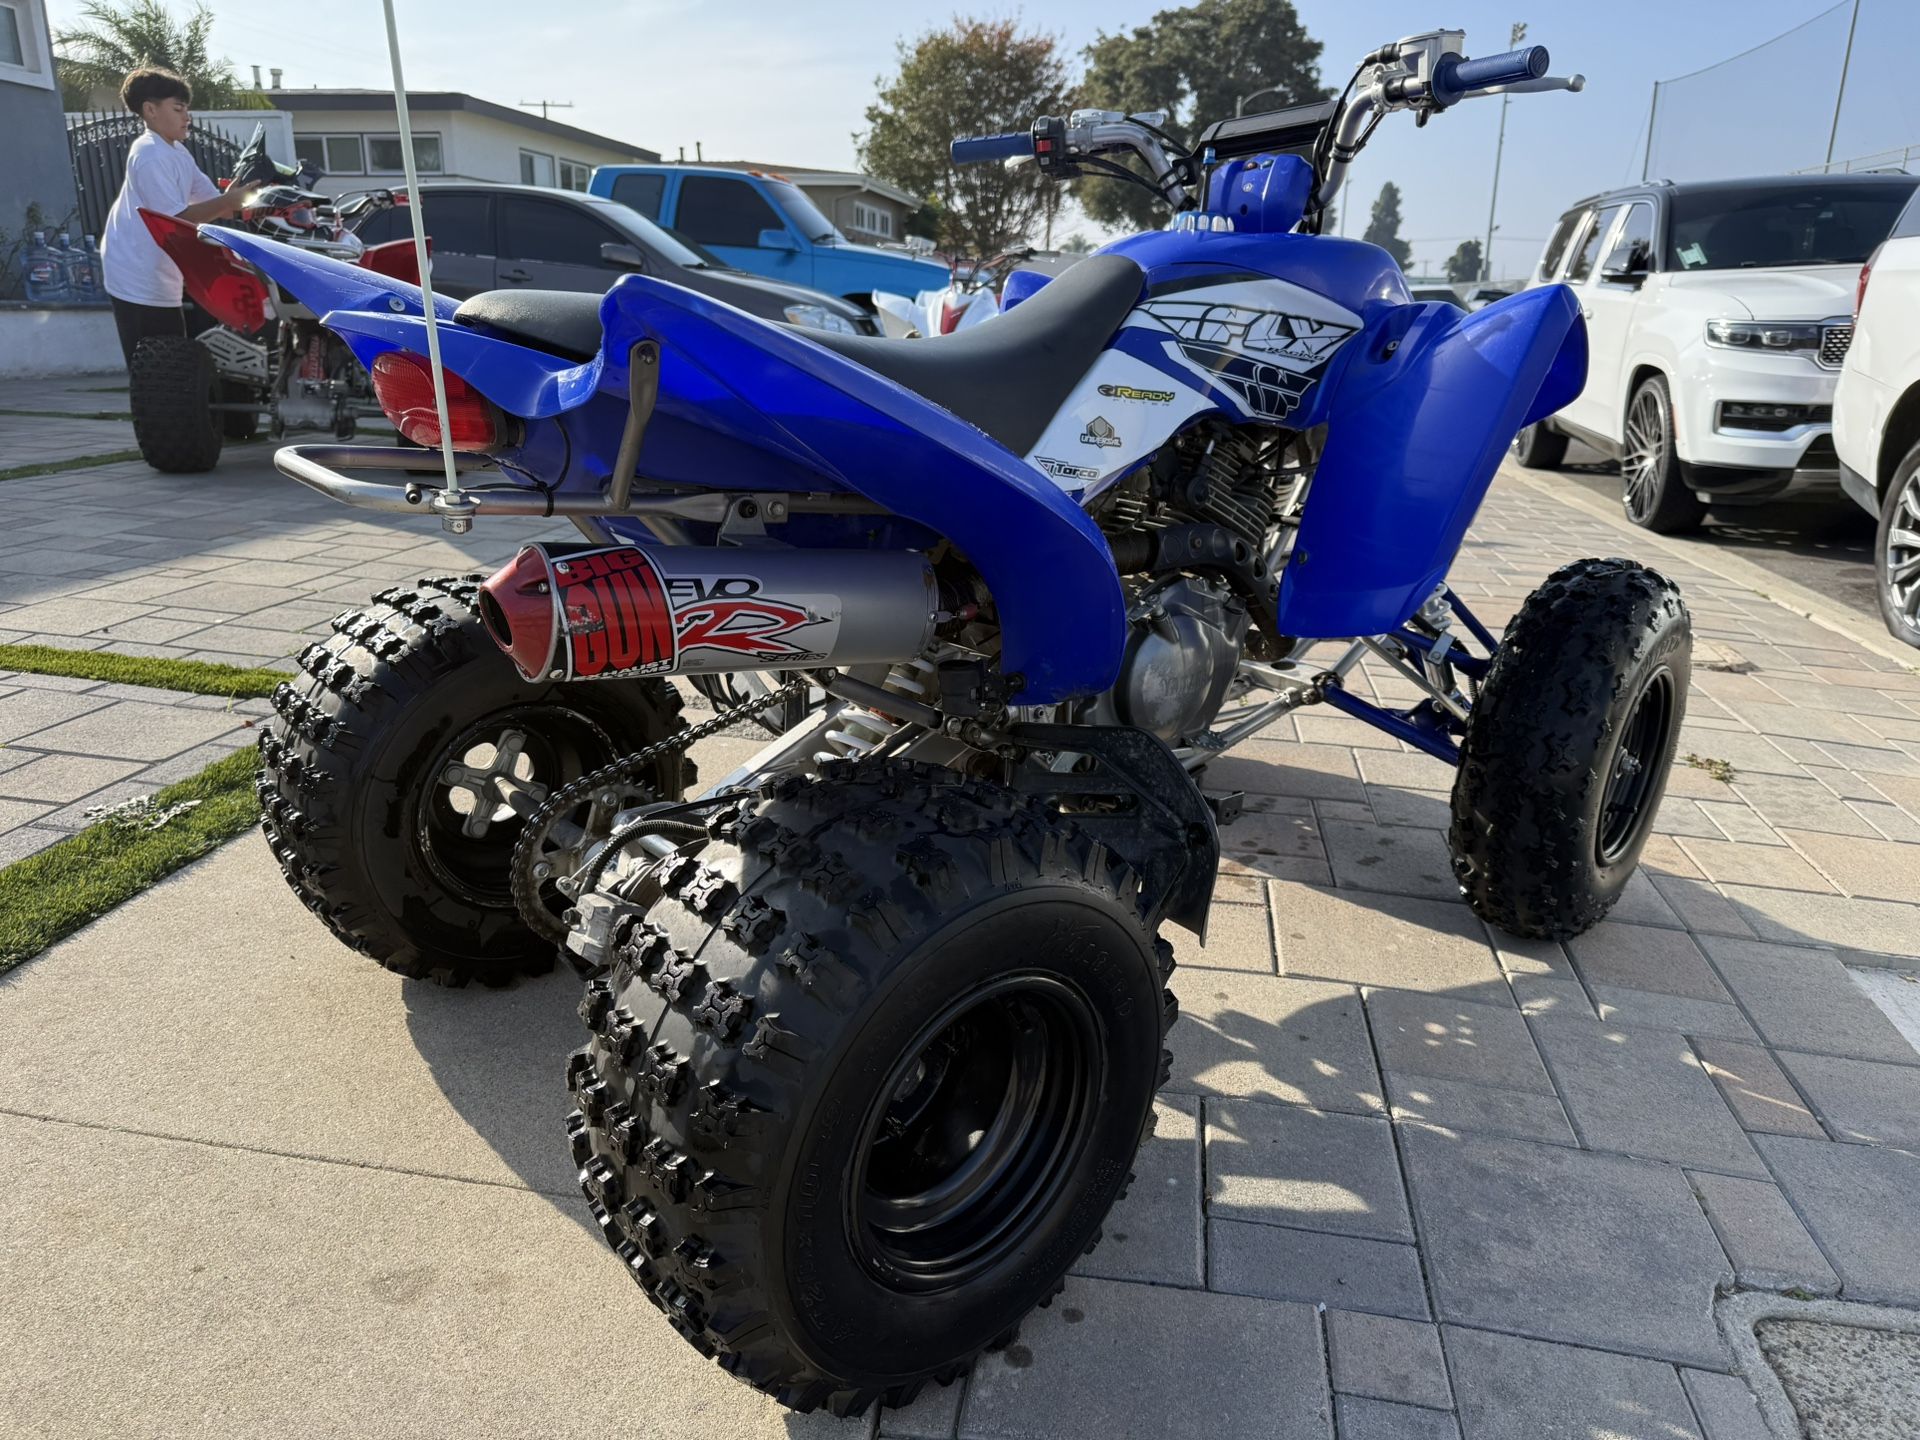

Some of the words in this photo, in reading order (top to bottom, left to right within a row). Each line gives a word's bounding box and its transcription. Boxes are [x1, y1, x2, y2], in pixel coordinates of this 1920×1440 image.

[1116, 386, 1175, 402] READY
[554, 548, 646, 588] BIG
[667, 579, 759, 600] EVO
[564, 564, 673, 677] GUN
[760, 652, 828, 662] SERIES
